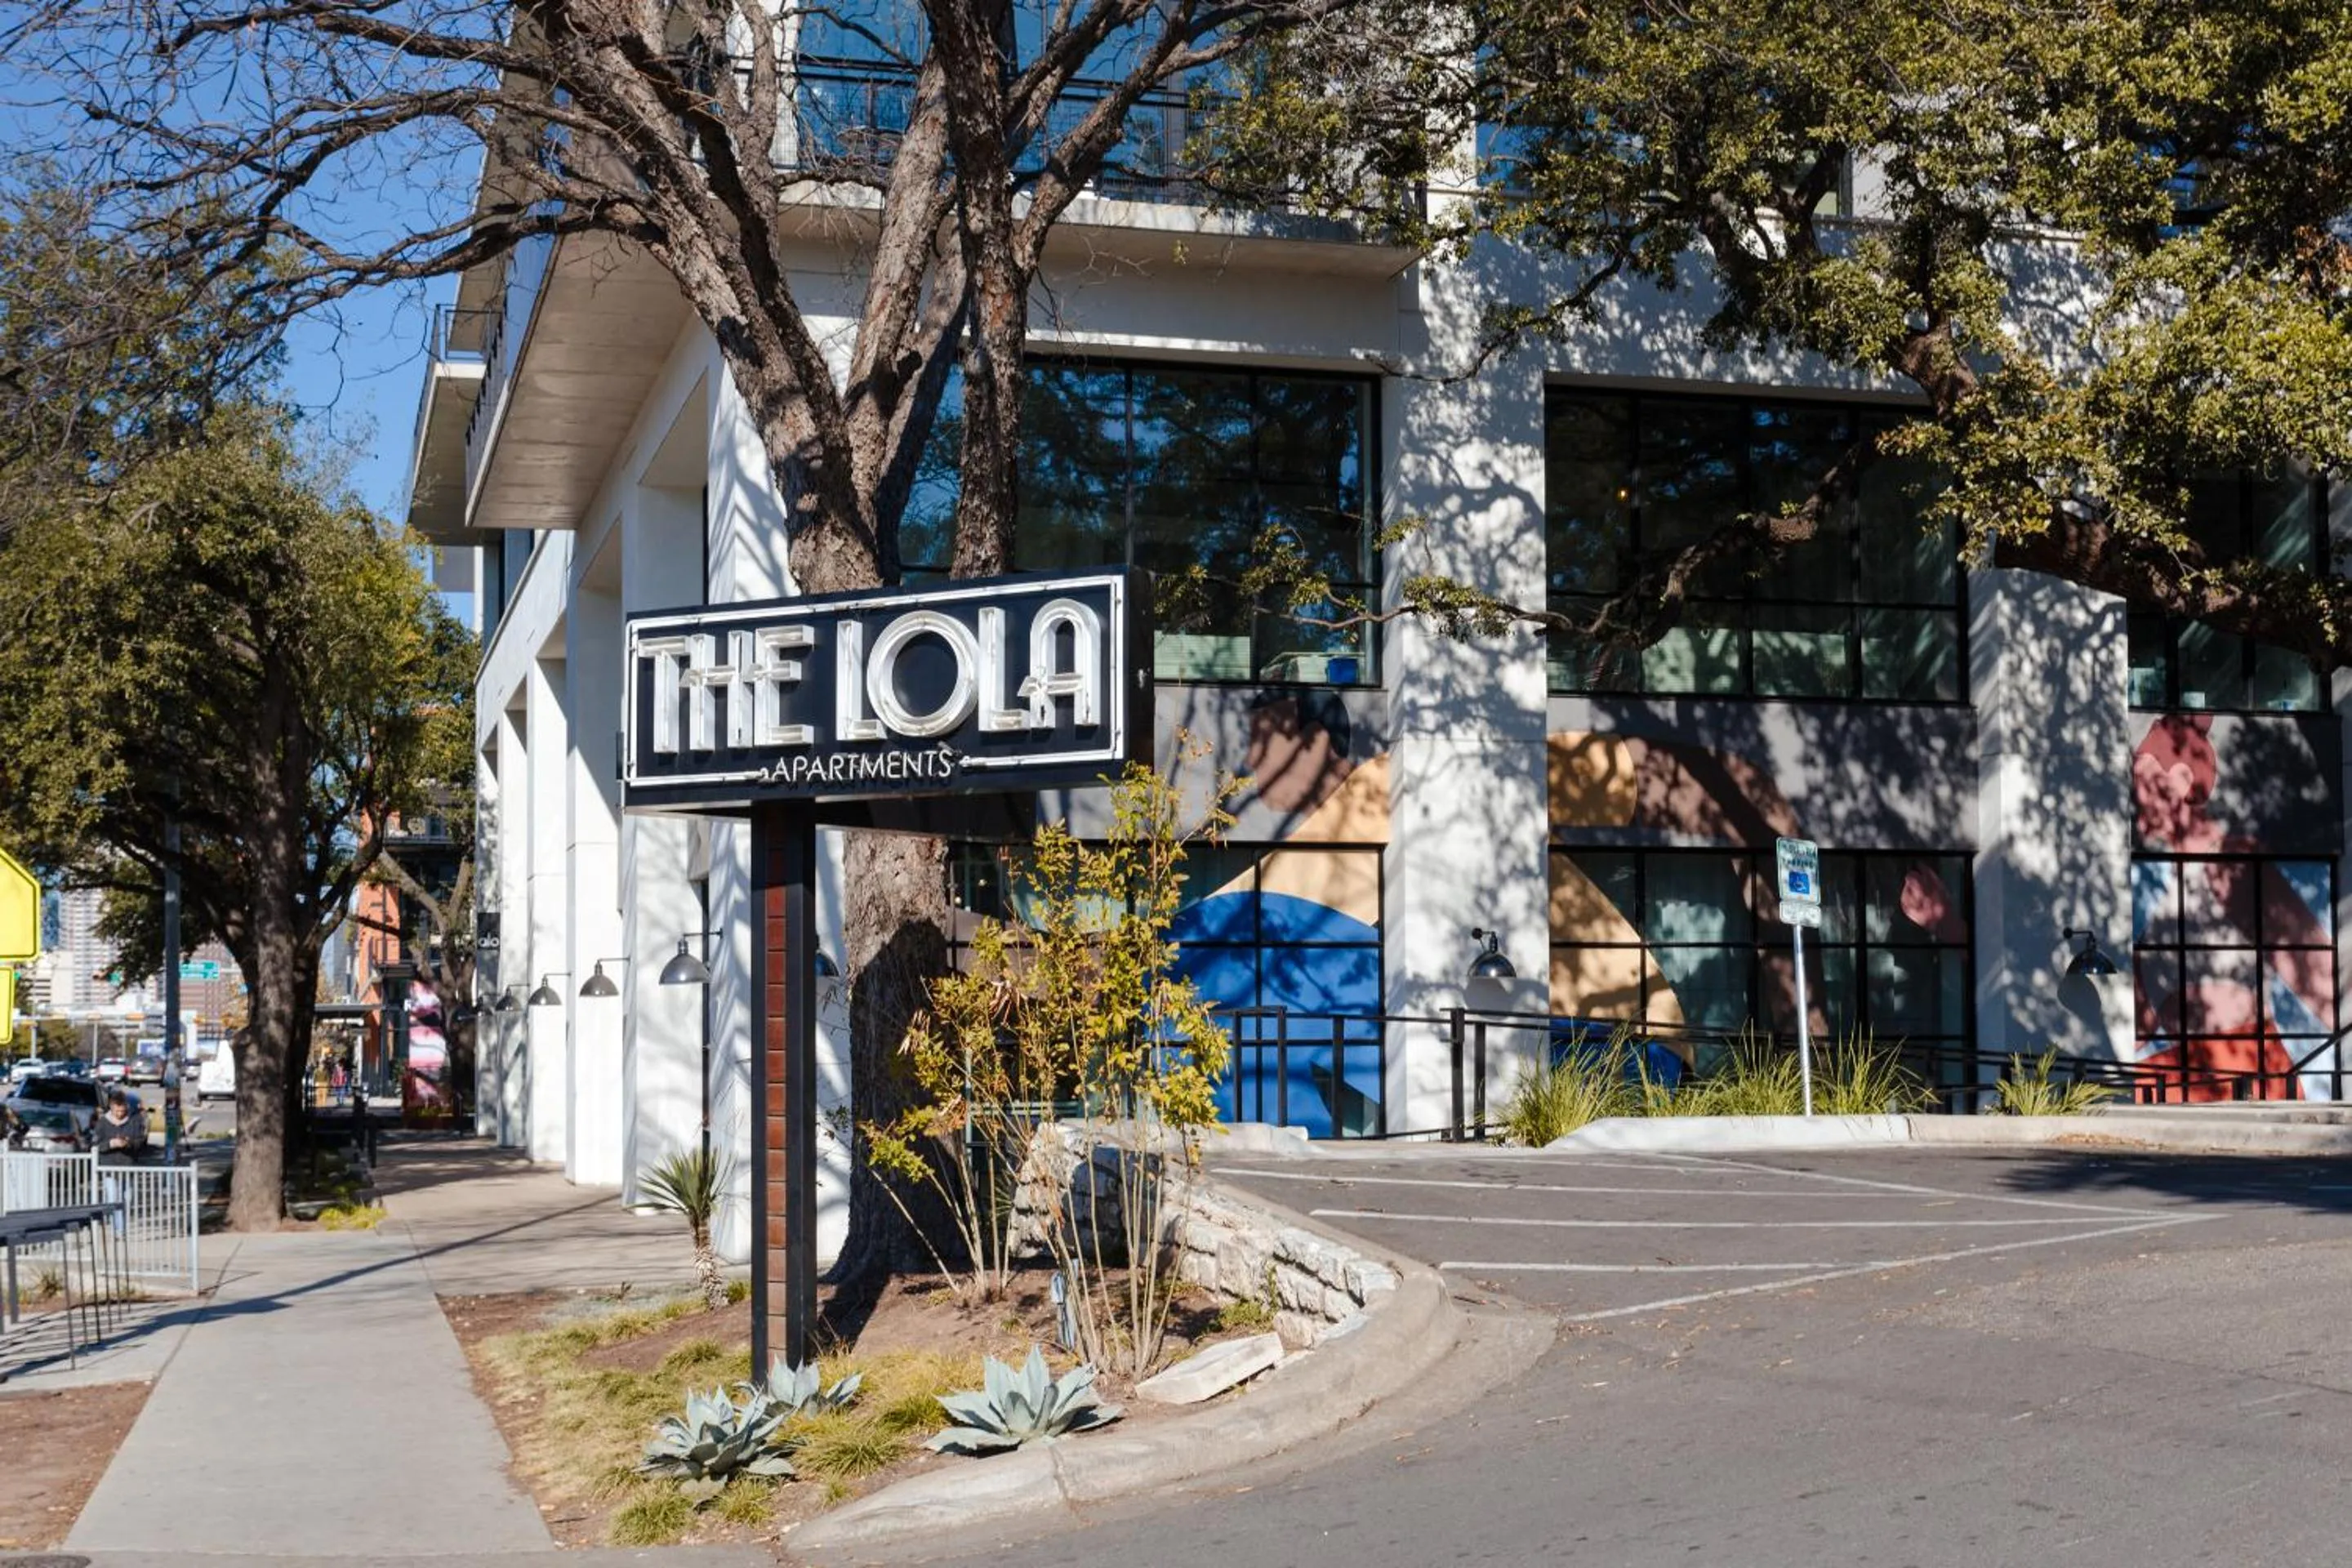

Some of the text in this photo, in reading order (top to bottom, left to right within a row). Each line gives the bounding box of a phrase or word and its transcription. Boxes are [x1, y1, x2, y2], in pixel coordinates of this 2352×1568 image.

[639, 599, 1101, 753] THE LOLA
[772, 751, 952, 782] APARTMENTS
